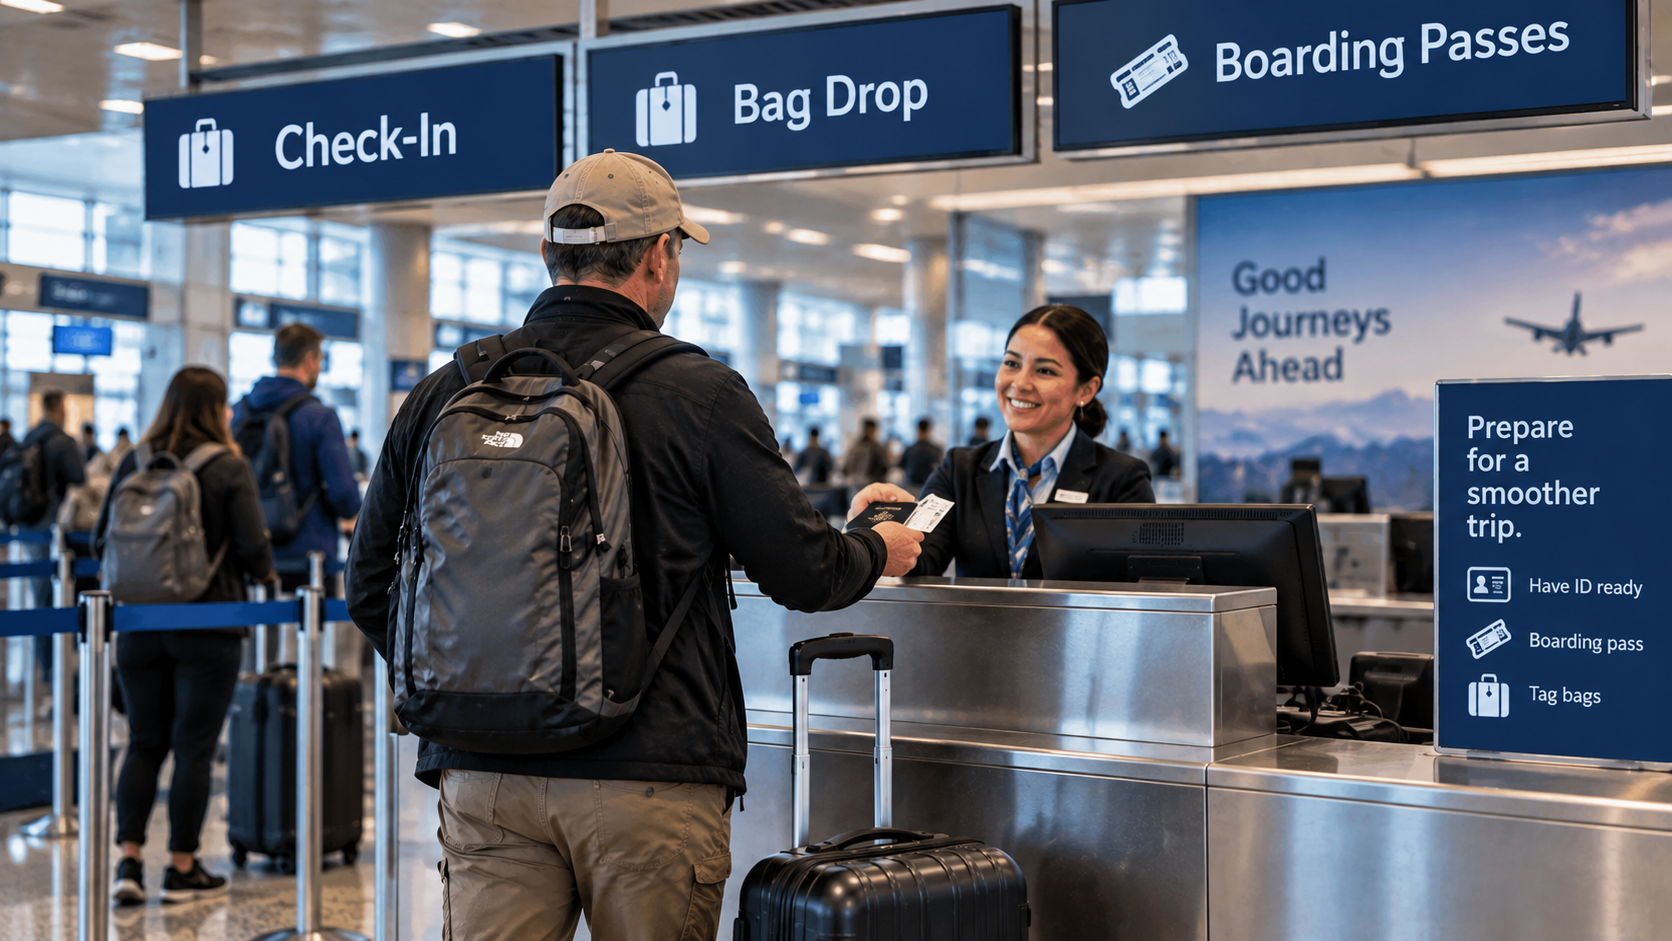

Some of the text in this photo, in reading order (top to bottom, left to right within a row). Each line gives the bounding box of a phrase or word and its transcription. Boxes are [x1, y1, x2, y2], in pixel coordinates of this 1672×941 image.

[1216, 20, 1570, 83] Boarding Passes
[734, 74, 928, 132] Bag Drop
[275, 112, 457, 170] Check-In
[1232, 257, 1326, 296] Good
[1232, 306, 1391, 344] Journeys
[1232, 346, 1344, 383] Ahead
[1467, 415, 1574, 444] Prepare
[1467, 446, 1529, 472] for a
[1467, 479, 1601, 506] smoother
[1467, 512, 1522, 544] trip.
[1529, 577, 1643, 600] Have ID ready
[1529, 632, 1644, 655] Boarding pass
[1529, 685, 1602, 708] Tag bags
